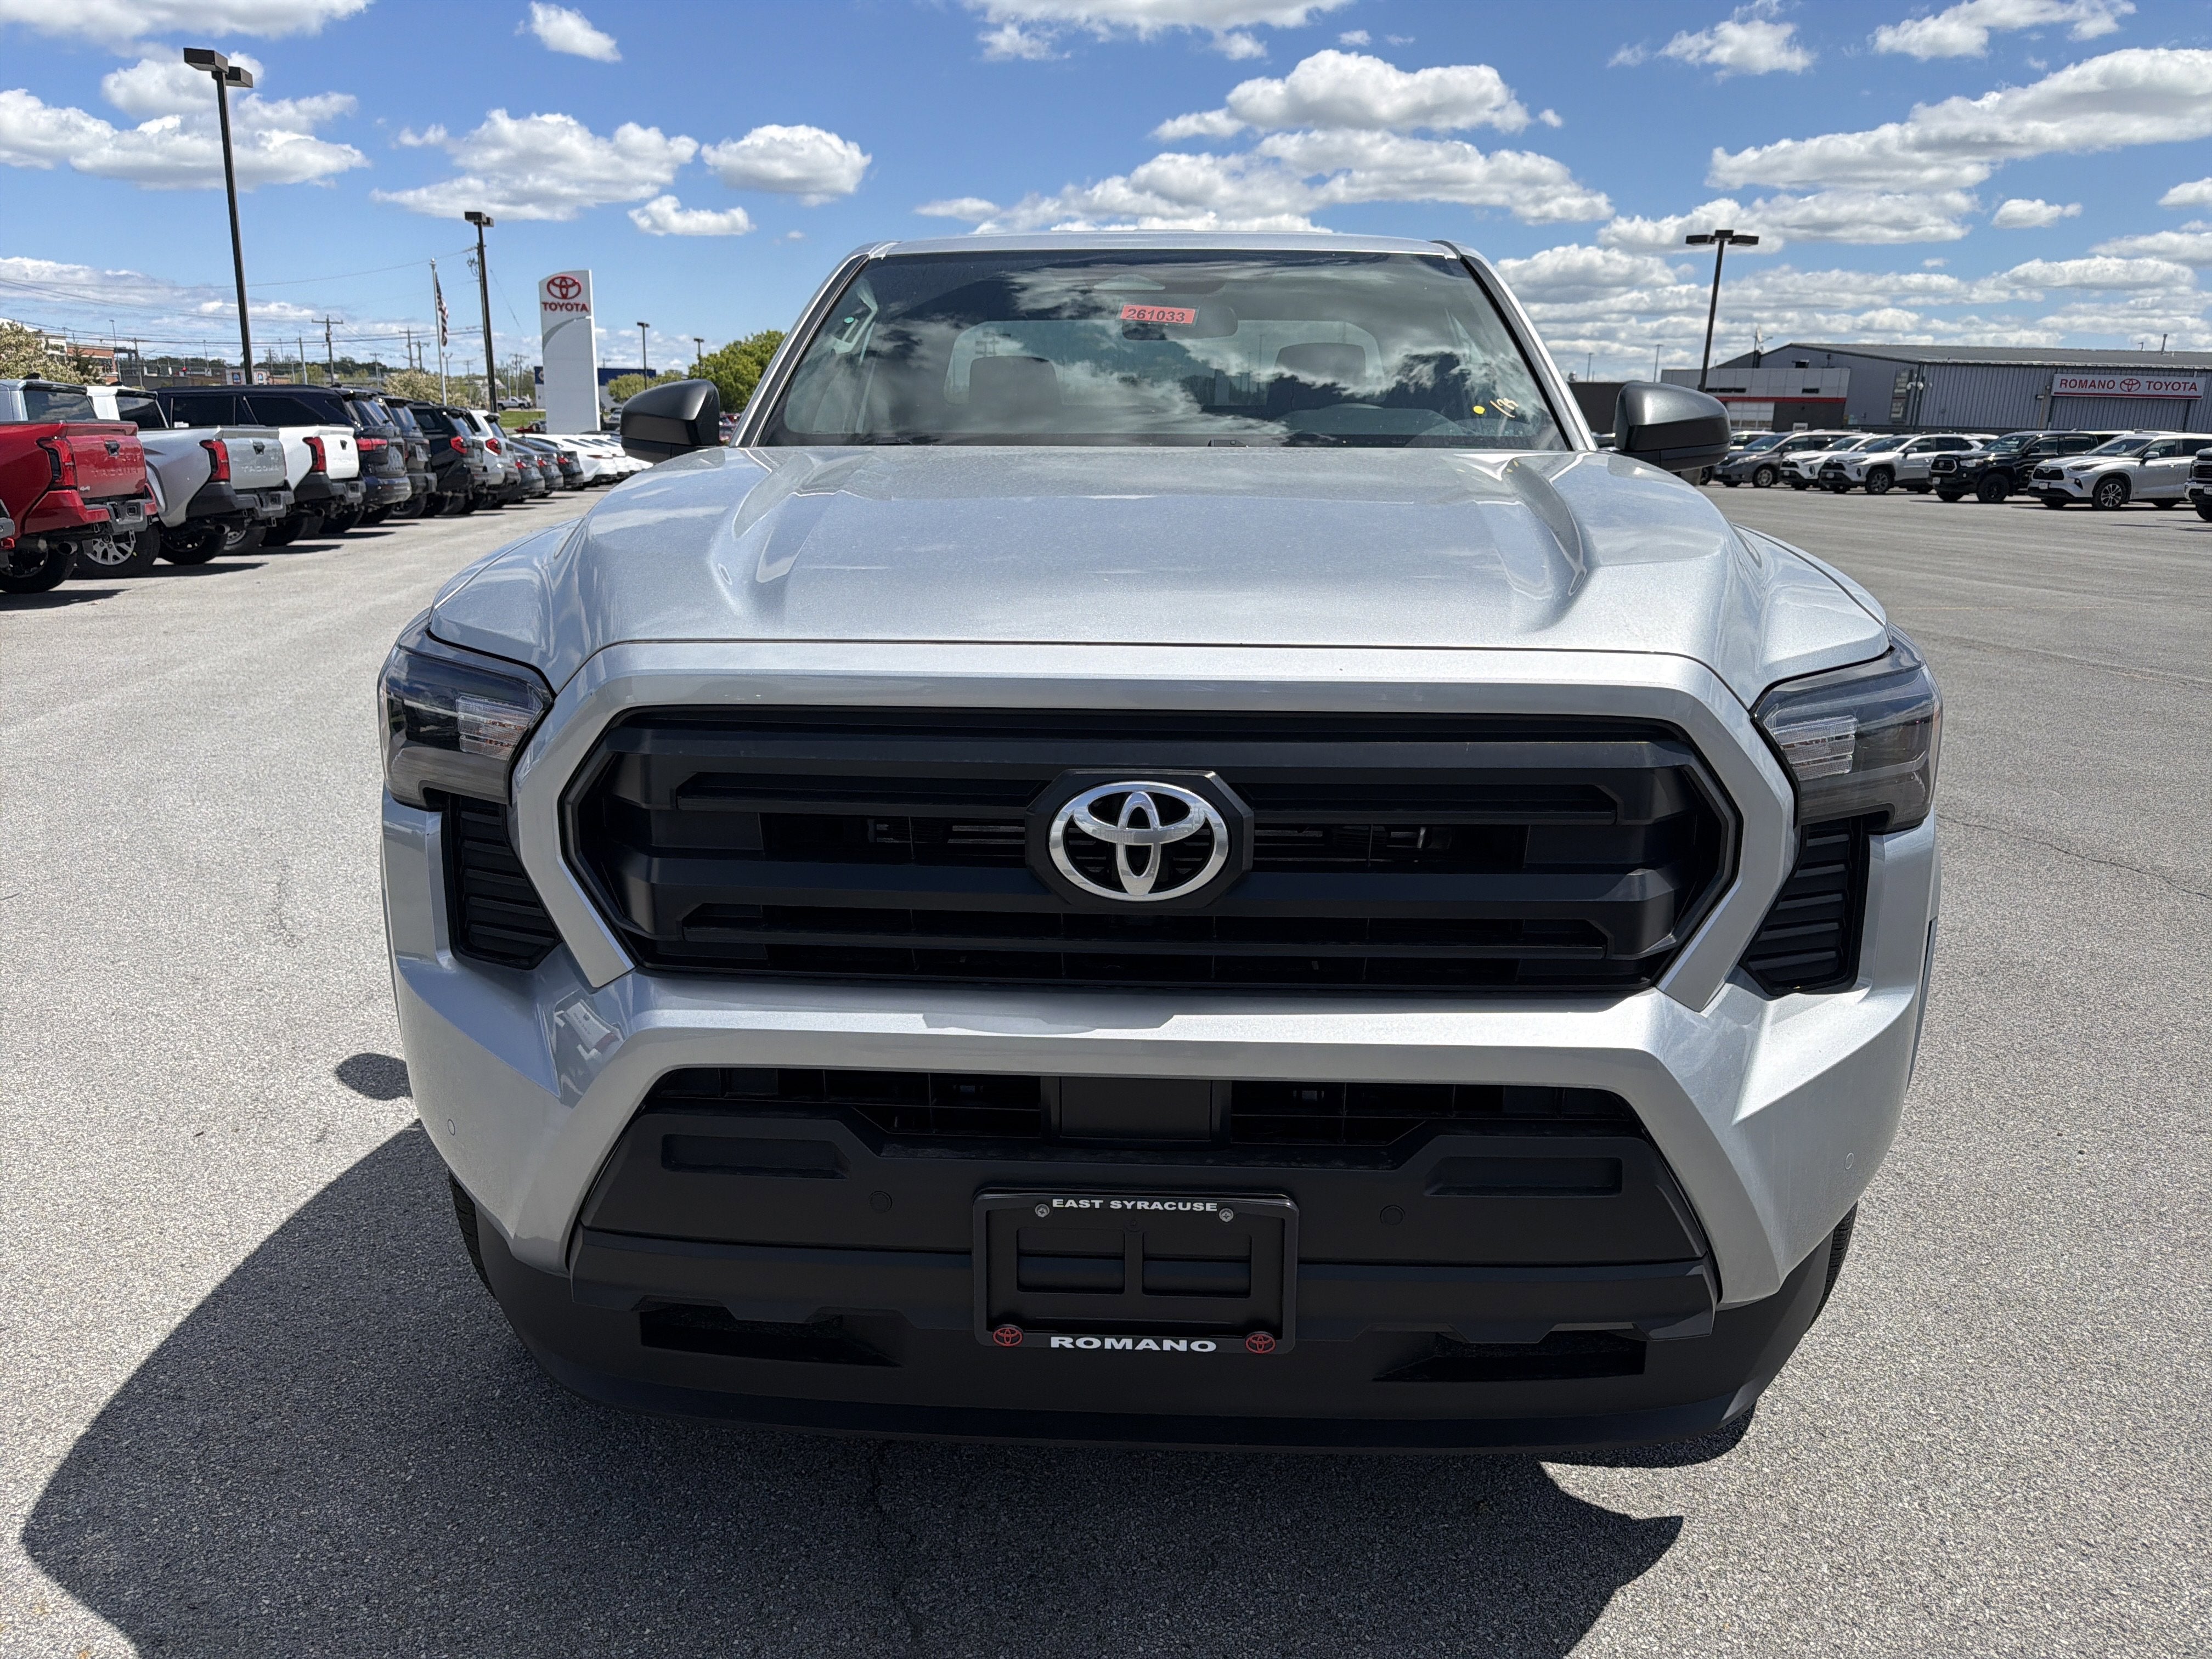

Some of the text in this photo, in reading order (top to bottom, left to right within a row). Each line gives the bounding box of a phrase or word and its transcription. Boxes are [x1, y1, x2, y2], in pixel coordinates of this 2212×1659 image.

[542, 302, 589, 313] TOYOTA
[1126, 308, 1185, 322] 261033
[2059, 379, 2197, 392] ROMANO TOYOTA
[1052, 1199, 1218, 1212] EAST SYRACUSE
[1051, 1336, 1217, 1352] ROMANO
